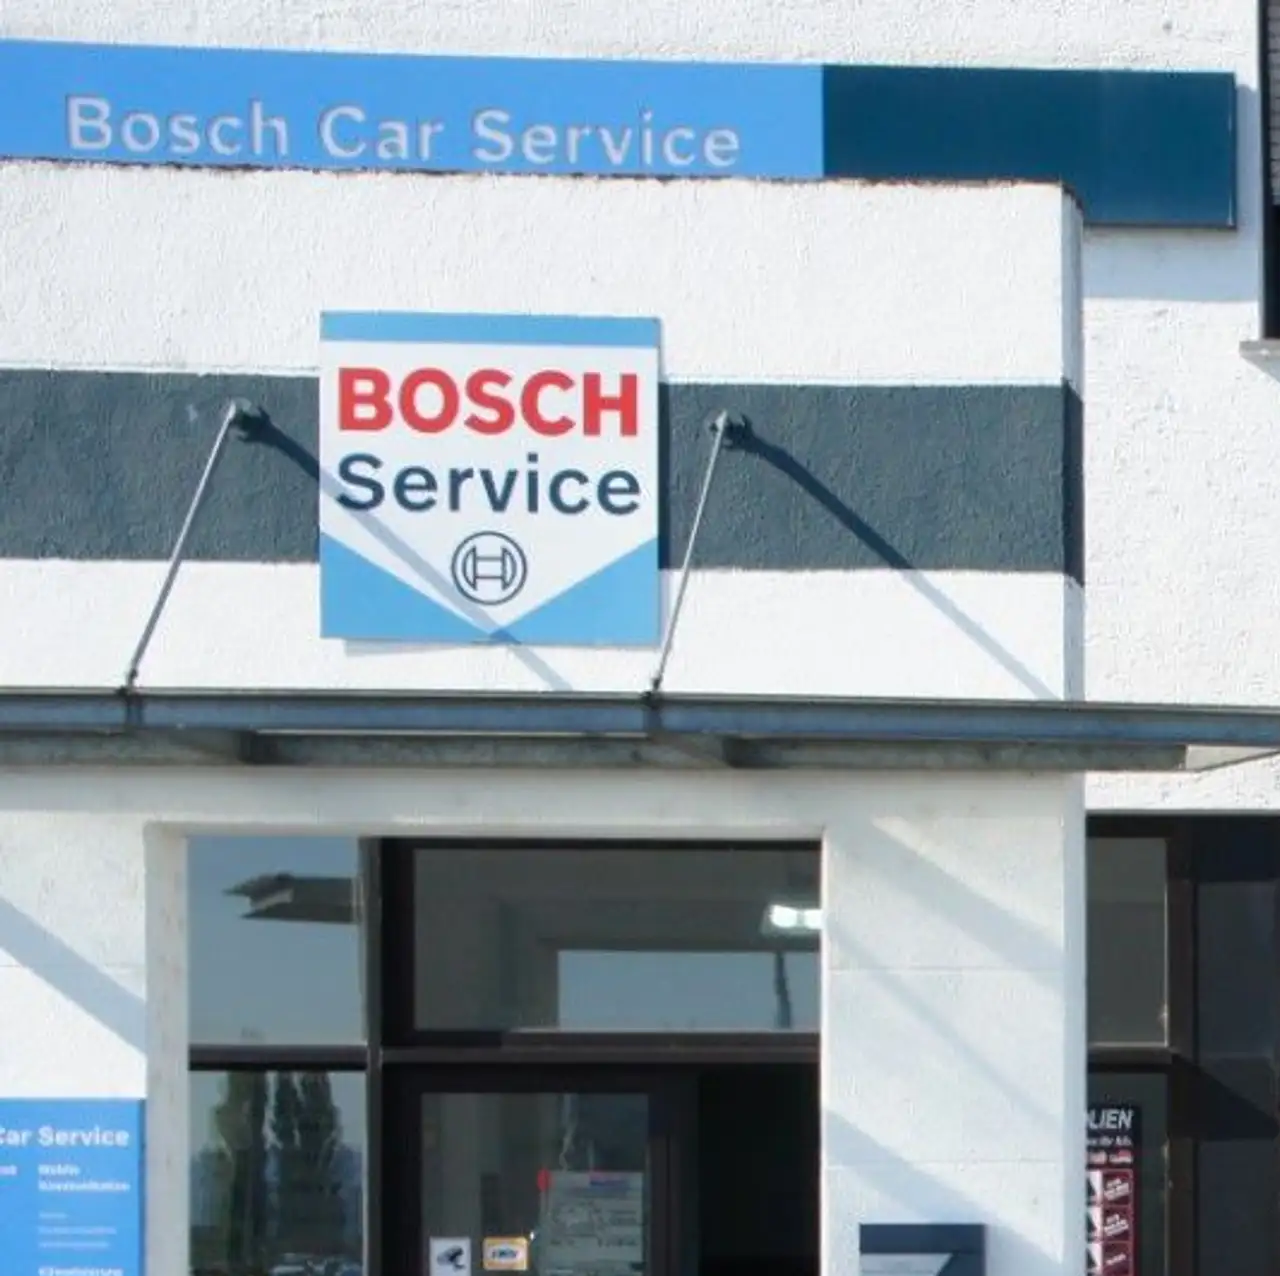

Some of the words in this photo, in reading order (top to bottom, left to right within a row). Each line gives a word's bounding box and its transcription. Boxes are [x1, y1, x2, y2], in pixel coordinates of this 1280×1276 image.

[67, 95, 289, 155] Bosch
[317, 103, 445, 161] Car
[470, 108, 740, 168] Service
[338, 367, 638, 437] BOSCH
[335, 452, 641, 516] Service
[38, 1124, 130, 1147] Service
[1087, 1108, 1134, 1130] LIEN
